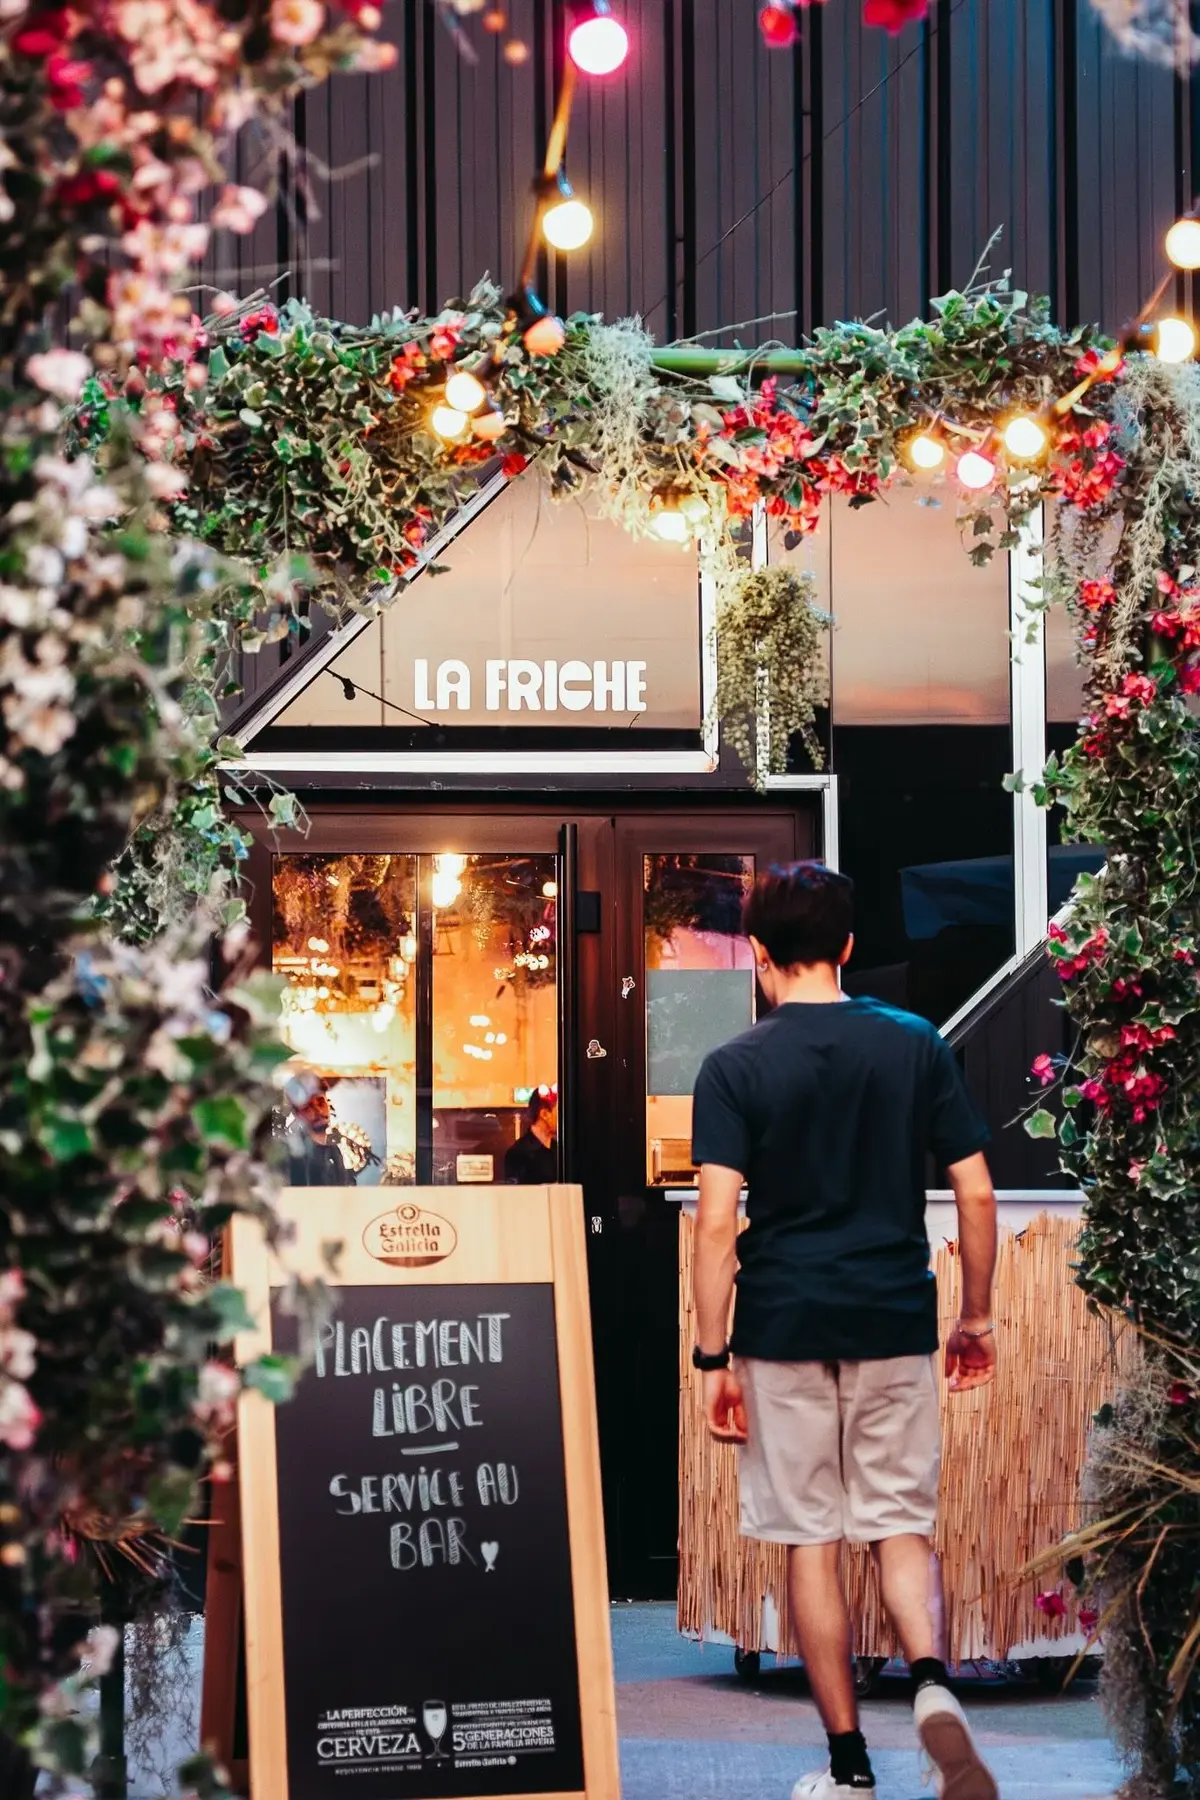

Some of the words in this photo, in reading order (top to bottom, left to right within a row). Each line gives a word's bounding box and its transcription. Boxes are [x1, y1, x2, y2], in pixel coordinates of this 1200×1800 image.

[414, 658, 471, 710] LA
[486, 659, 647, 711] FRICHE
[379, 1223, 441, 1238] Estrella
[381, 1238, 439, 1253] Galicia
[315, 1313, 511, 1378] PLACEMENT
[476, 1463, 519, 1506] AU
[390, 1518, 478, 1570] BAR
[326, 1710, 340, 1720] LA
[341, 1705, 408, 1719] PERFECCIÓN
[316, 1732, 421, 1758] CERVEZA
[452, 1731, 466, 1751] 5
[465, 1726, 554, 1741] GENERACIONES
